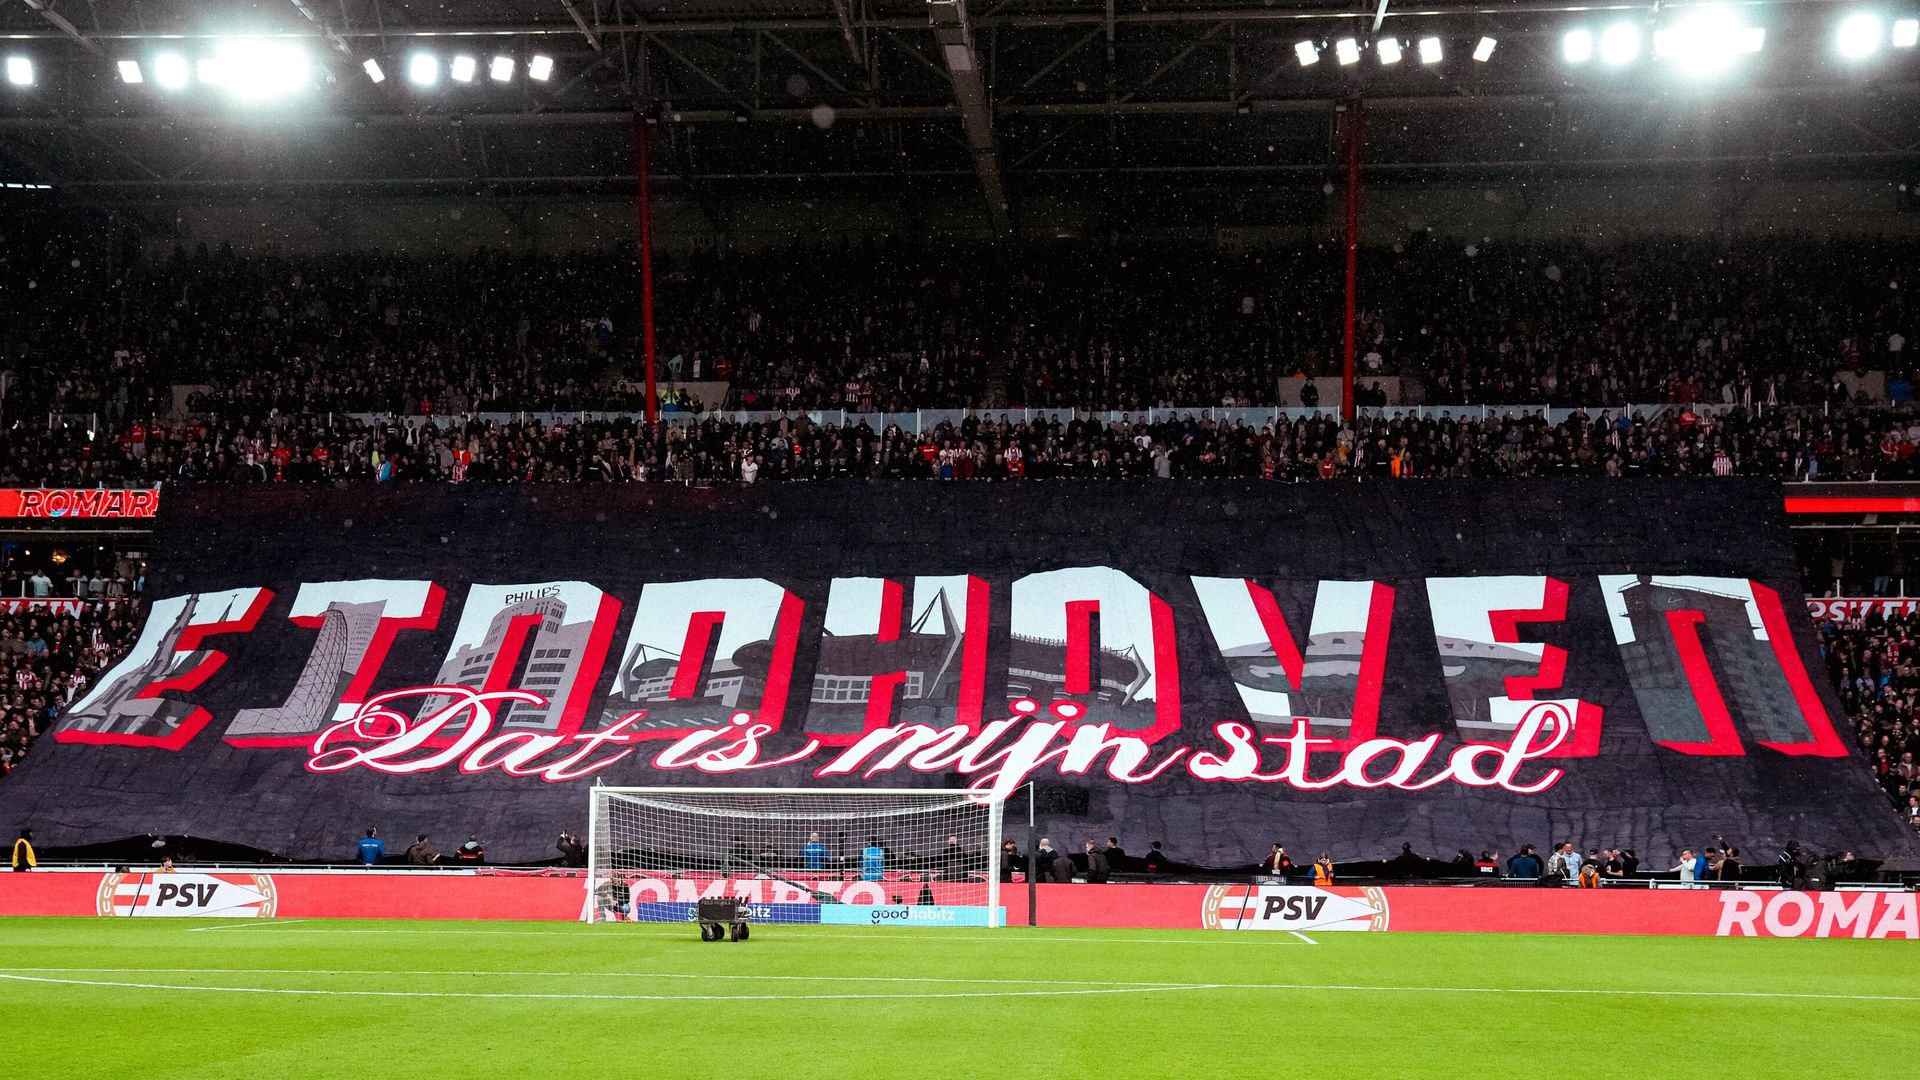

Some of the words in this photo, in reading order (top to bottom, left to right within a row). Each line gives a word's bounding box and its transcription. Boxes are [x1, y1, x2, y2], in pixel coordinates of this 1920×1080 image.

[505, 585, 561, 605] PHILIPS
[304, 684, 647, 783] Dat
[651, 710, 821, 775] is
[813, 697, 1188, 807] mijn
[1185, 699, 1577, 793] stad
[156, 883, 219, 907] PSV
[871, 906, 956, 925] goodhabitz
[1263, 895, 1327, 920] PSV
[1716, 890, 1920, 939] ROMA
